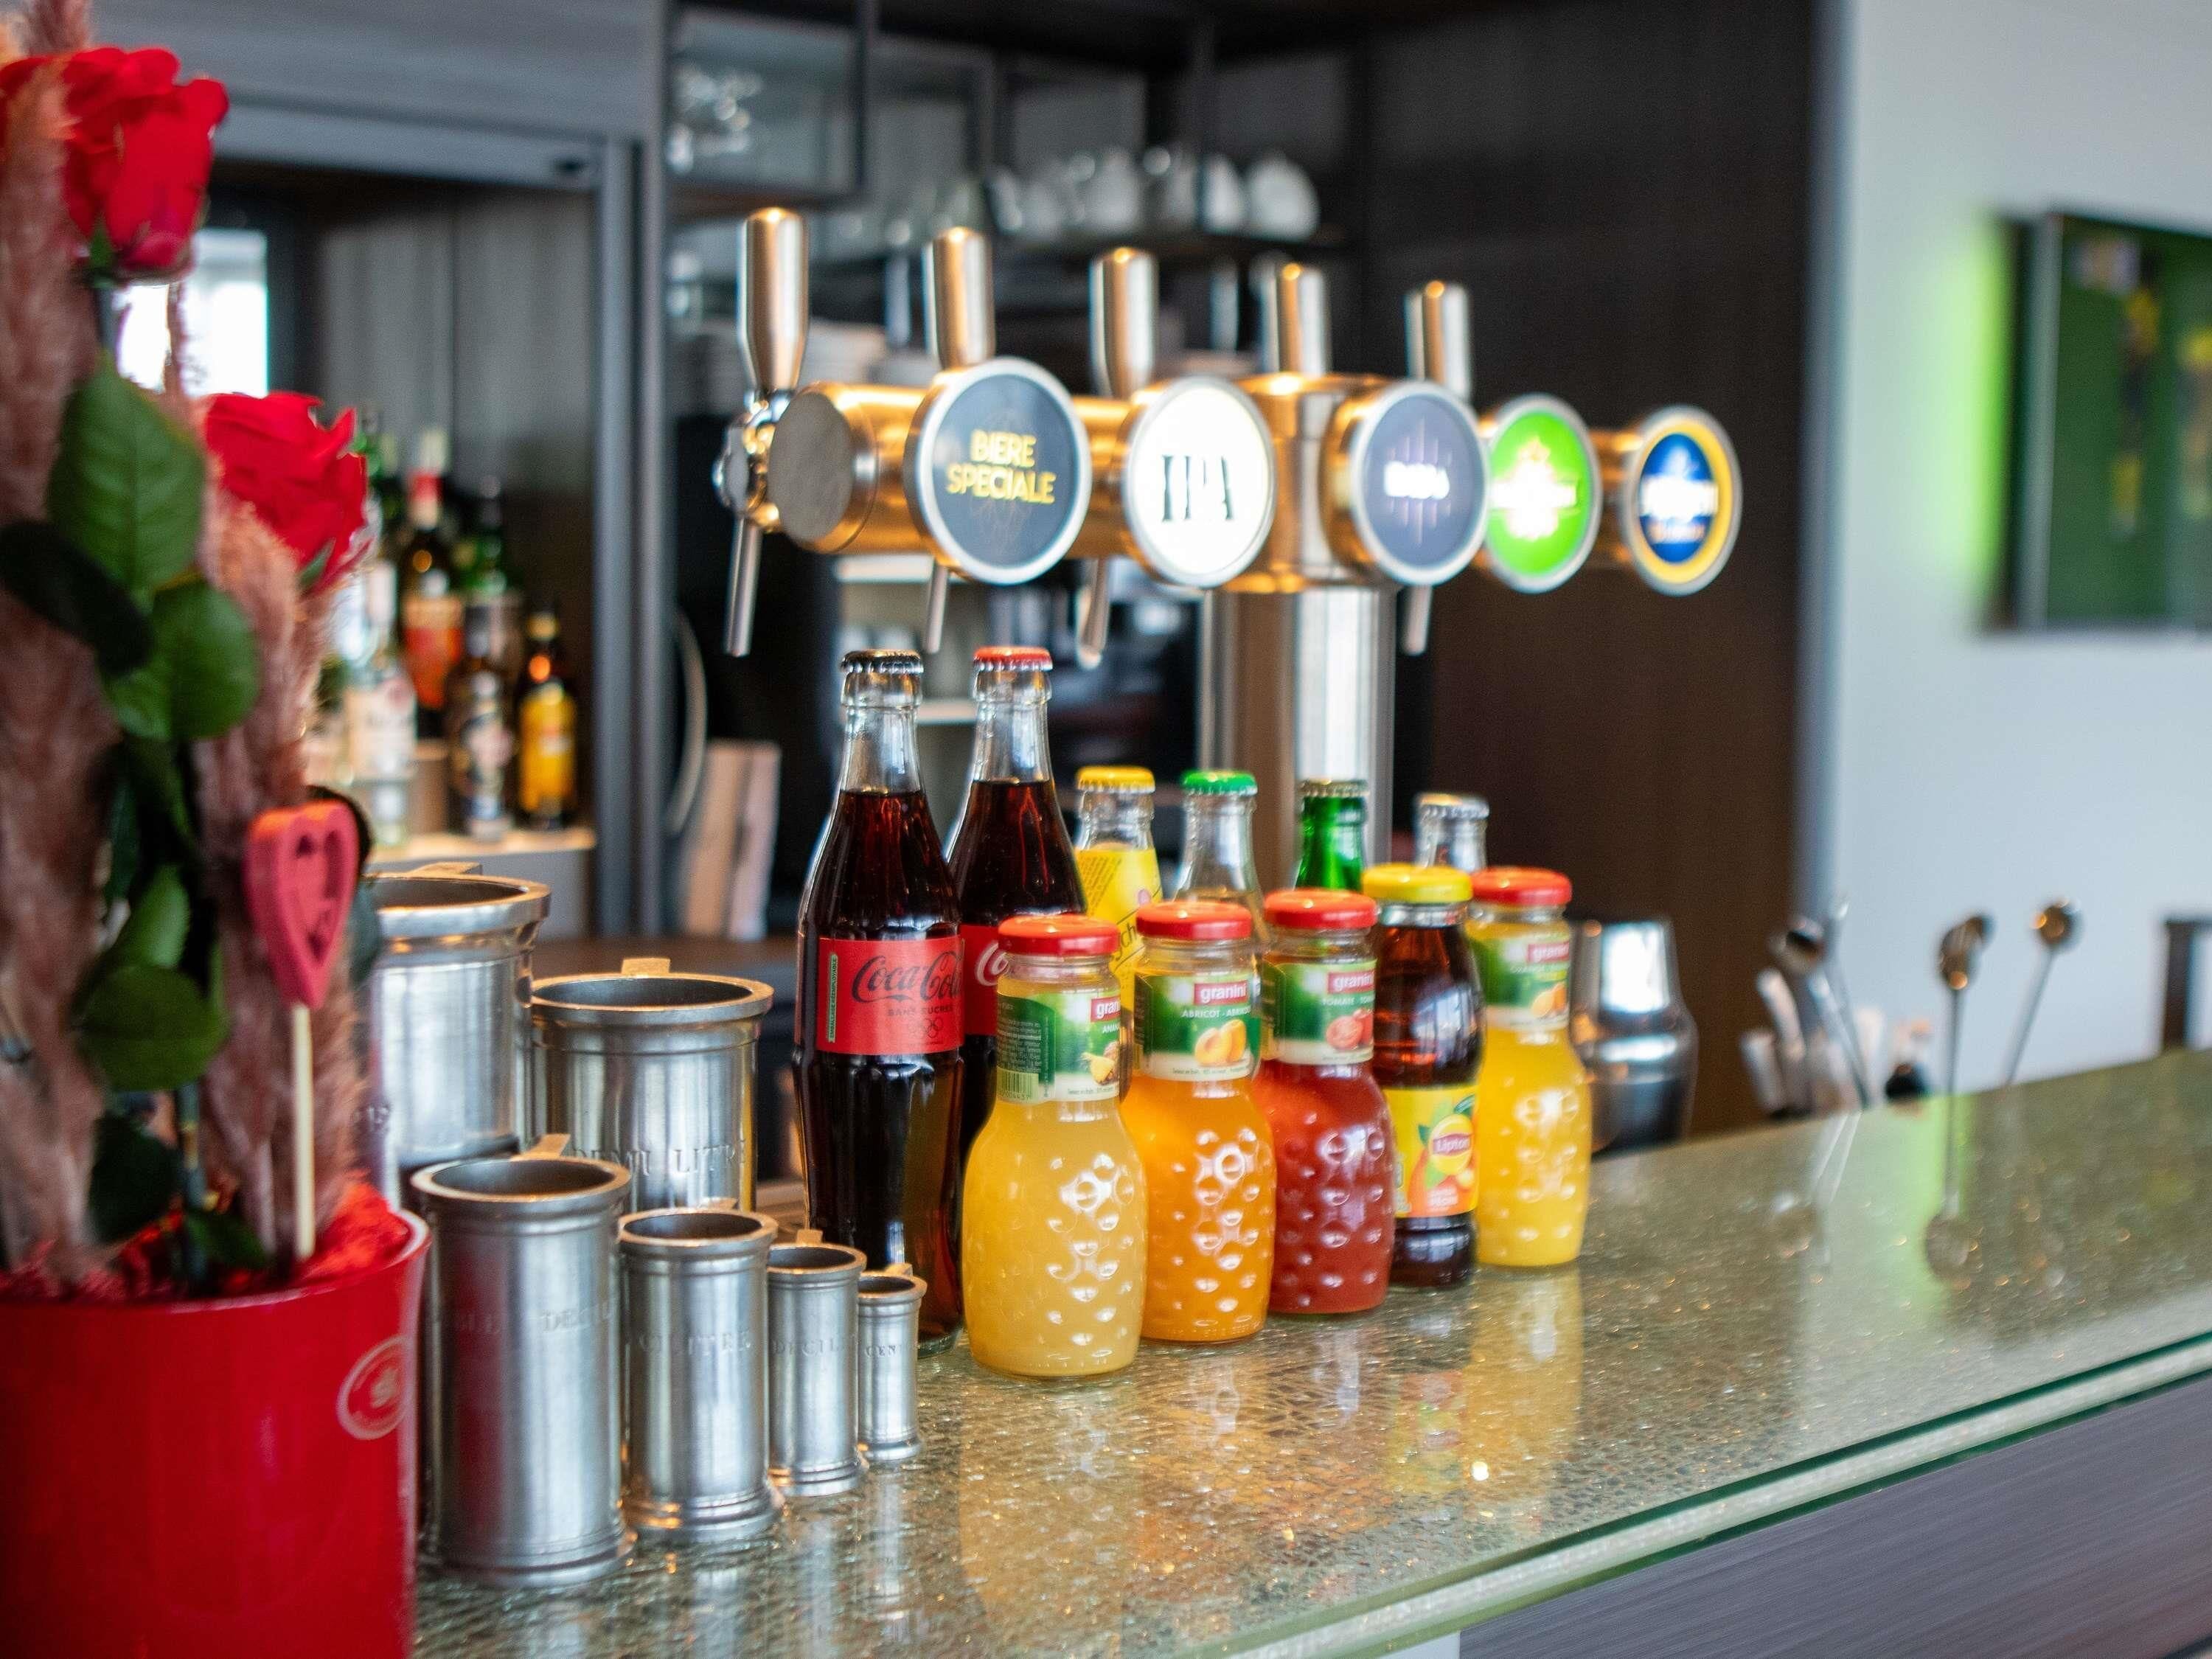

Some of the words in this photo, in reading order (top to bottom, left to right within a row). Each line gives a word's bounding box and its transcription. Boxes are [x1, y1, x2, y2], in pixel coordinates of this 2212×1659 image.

[970, 429, 1037, 468] BIERE
[945, 462, 1057, 504] SPECIALE
[1161, 454, 1234, 521] IPA
[1200, 981, 1247, 1004] granini
[1181, 1009, 1220, 1018] ABRICOT
